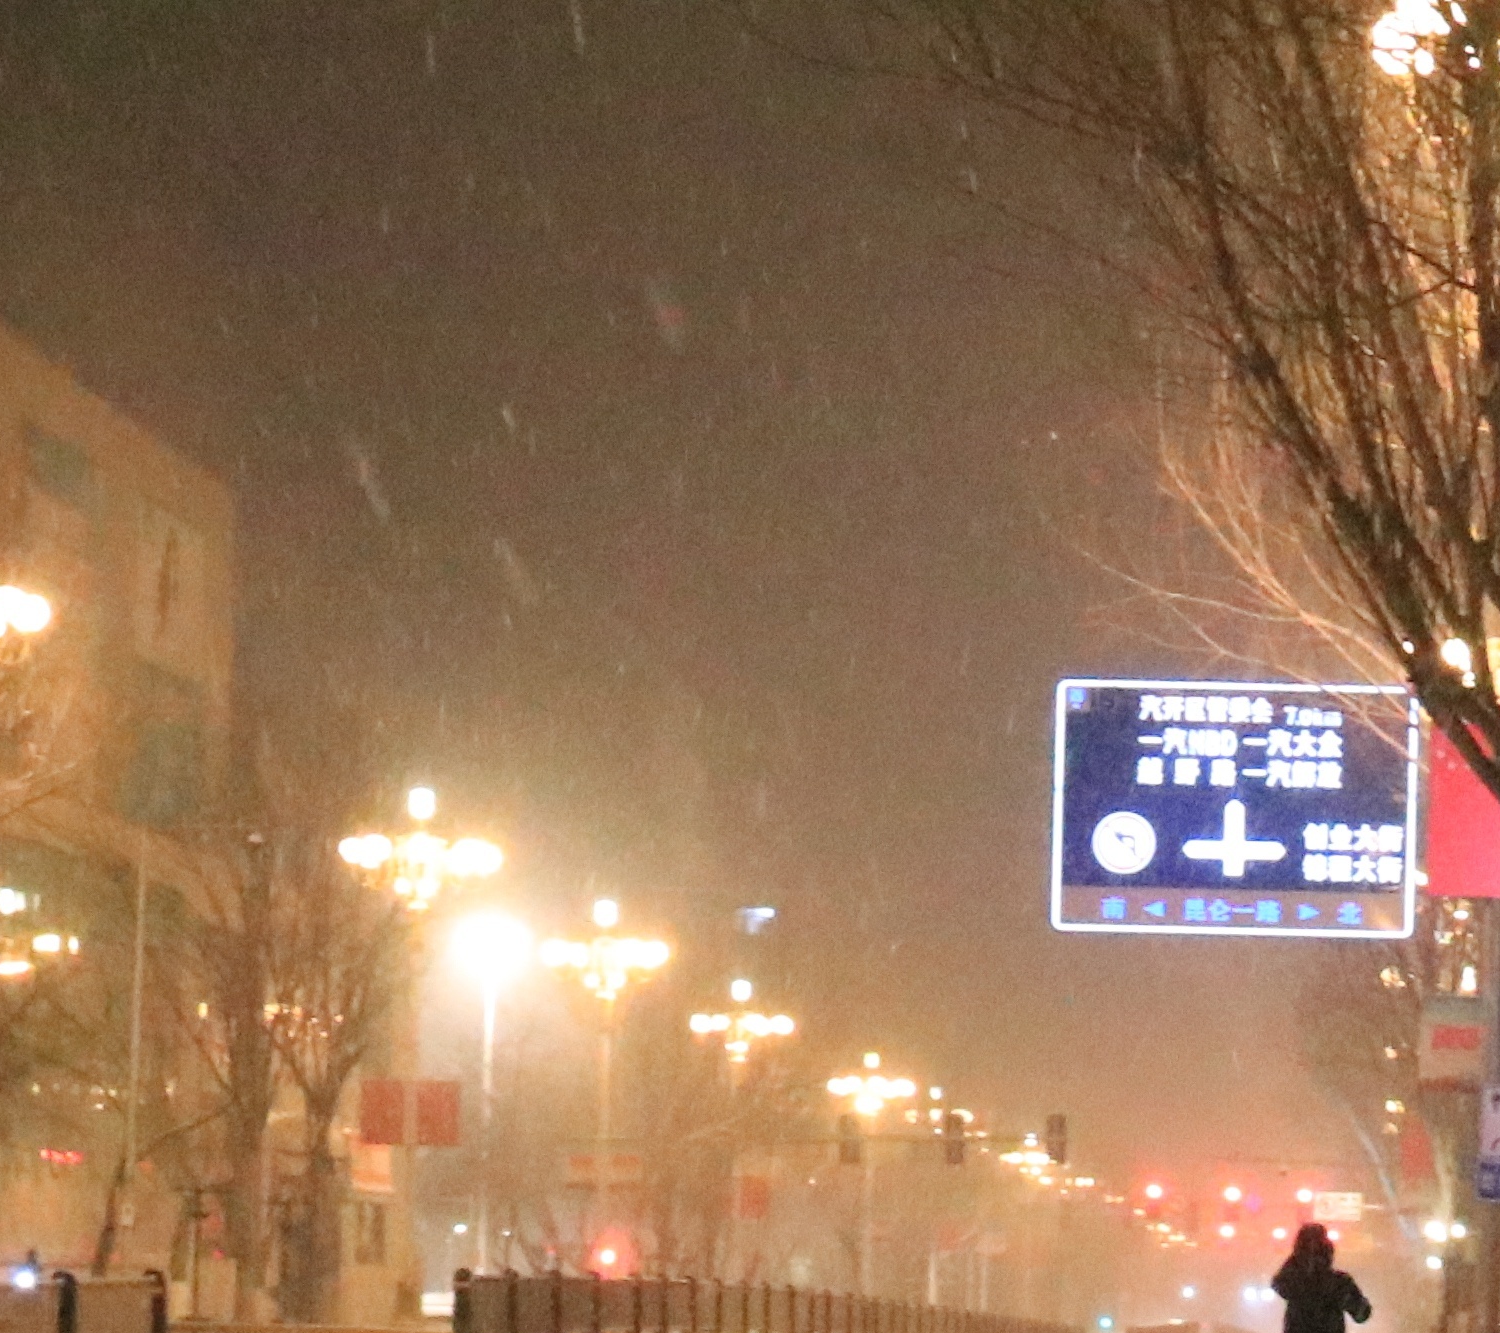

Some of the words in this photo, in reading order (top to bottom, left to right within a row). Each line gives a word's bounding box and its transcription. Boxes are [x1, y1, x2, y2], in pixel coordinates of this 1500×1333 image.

[1138, 694, 1273, 724] 汽开区管委会
[1242, 730, 1343, 759] 一汽大众
[1302, 823, 1403, 852] 创业大街
[1337, 902, 1363, 926] 北
